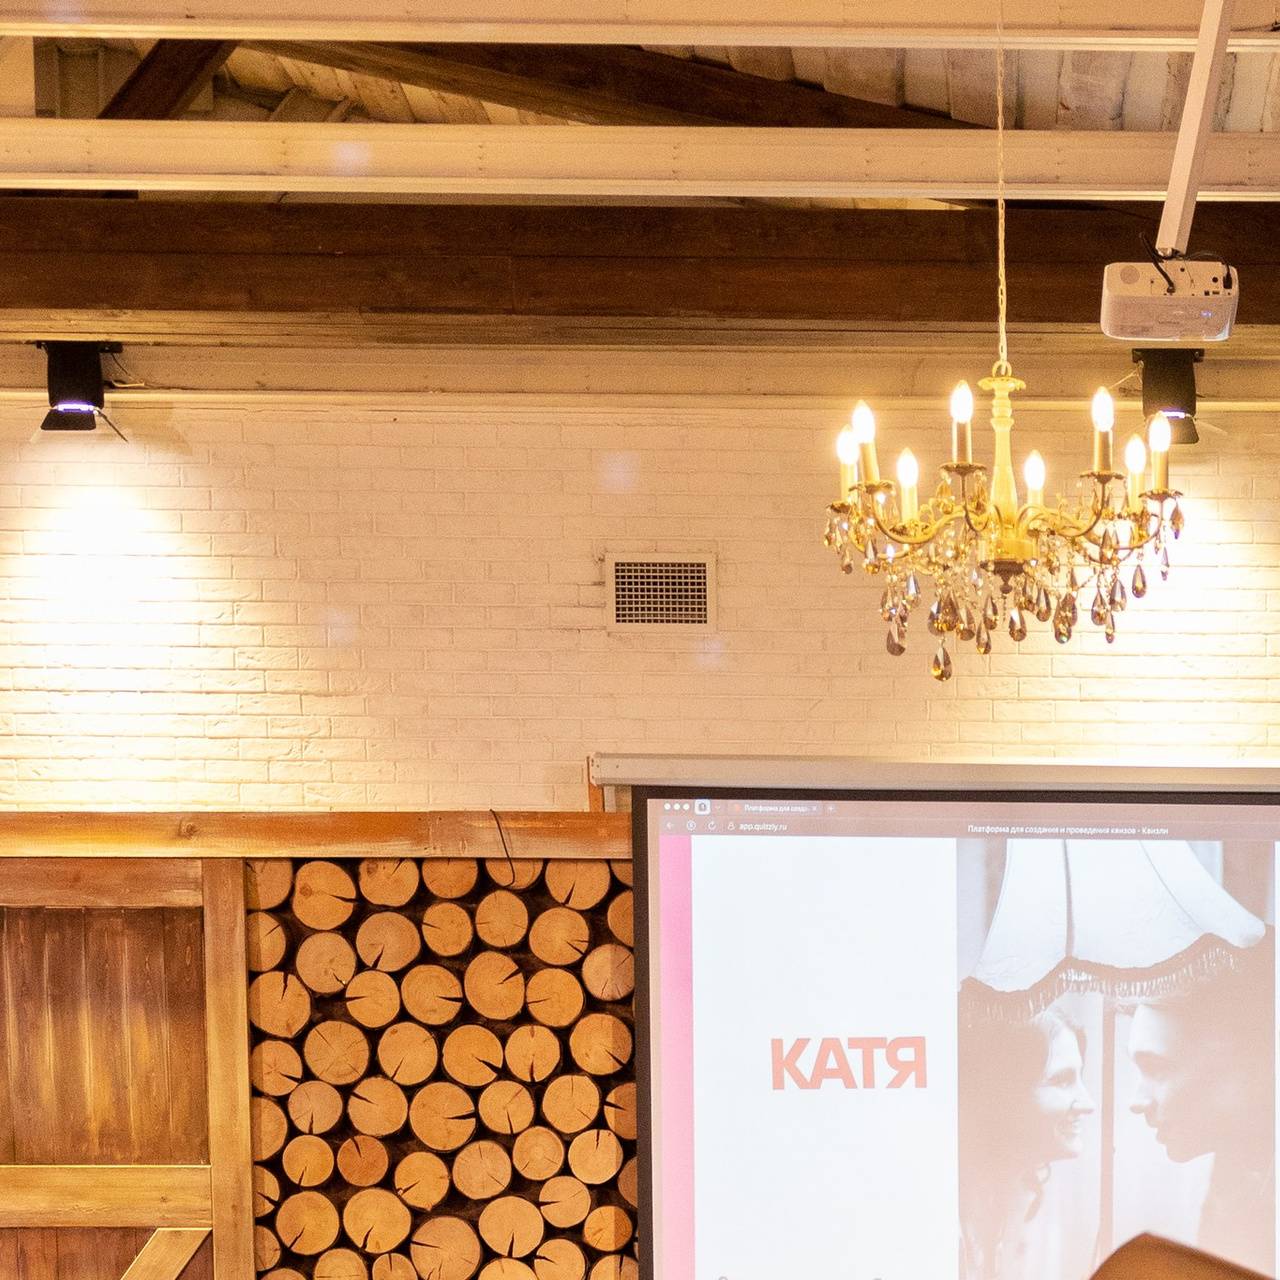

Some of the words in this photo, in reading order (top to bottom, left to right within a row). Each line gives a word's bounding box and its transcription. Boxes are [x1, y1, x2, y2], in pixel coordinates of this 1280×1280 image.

[739, 823, 788, 832] app.quizzly.ru
[967, 824, 1009, 835] Платформа
[1010, 826, 1023, 834] для
[1025, 826, 1058, 835] создания
[1066, 827, 1109, 835] проведения
[1110, 827, 1136, 835] квизов
[1142, 827, 1169, 835] Квизли
[771, 1036, 928, 1090] КАТЯ
